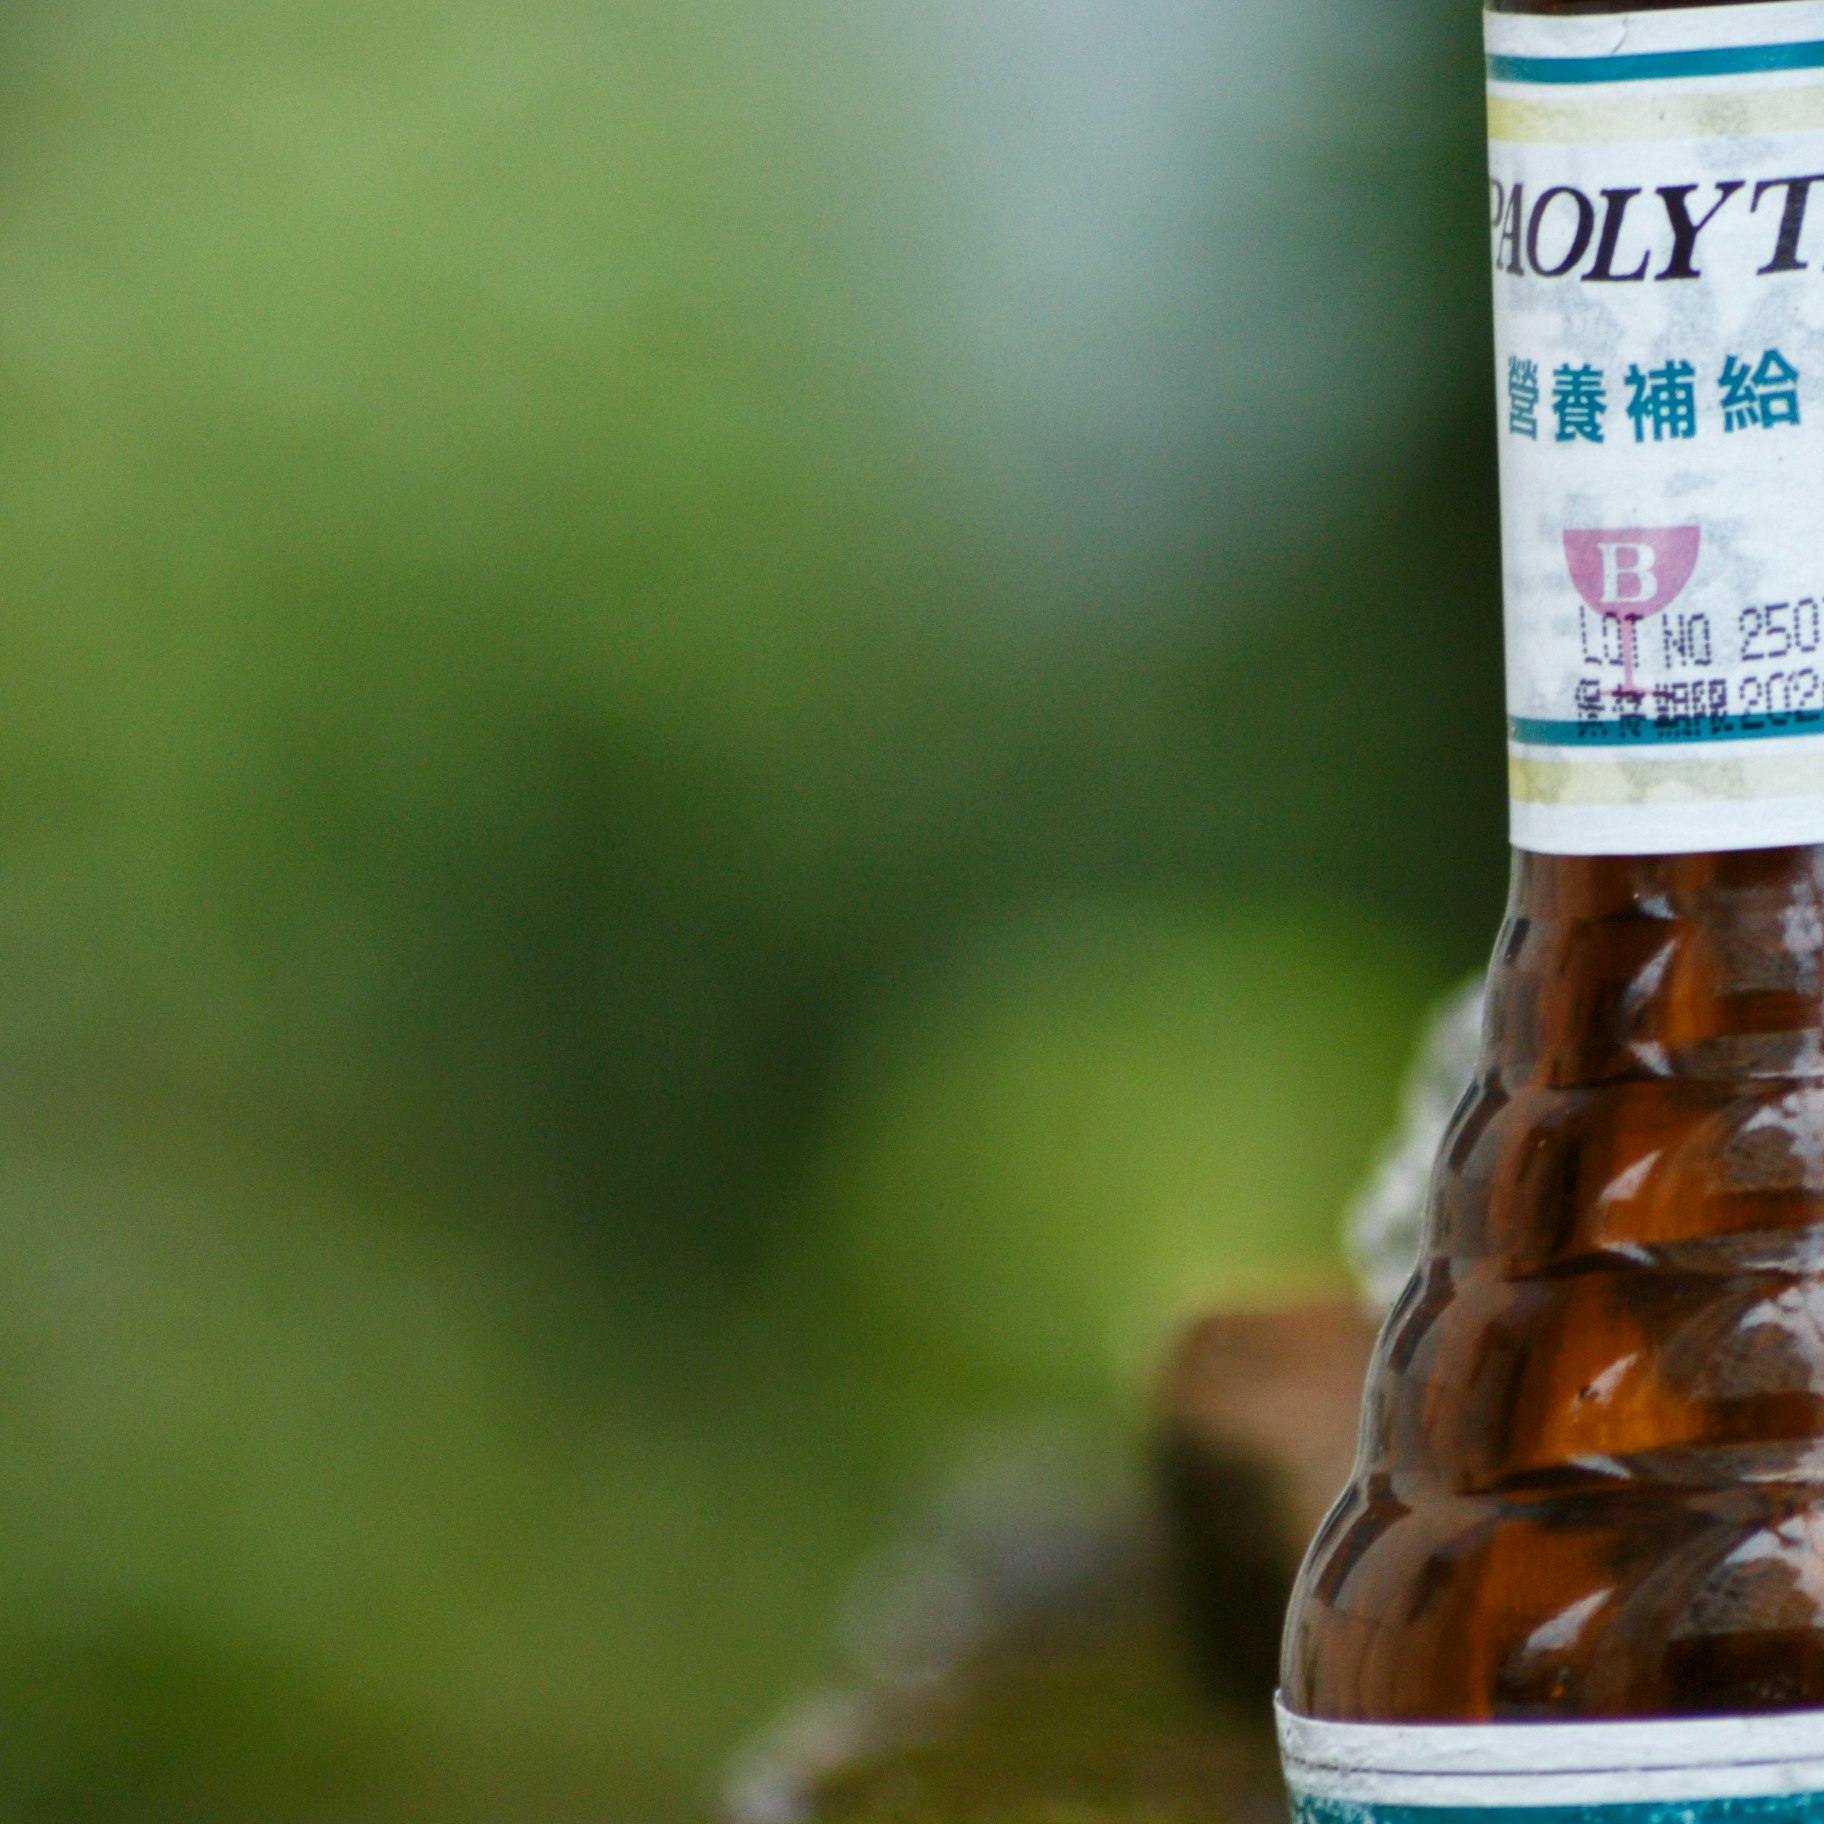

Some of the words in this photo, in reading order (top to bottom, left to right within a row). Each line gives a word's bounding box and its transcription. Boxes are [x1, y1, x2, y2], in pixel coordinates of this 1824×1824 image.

[1507, 347, 1801, 445] 營養補給
[1597, 542, 1658, 603] B
[1579, 605, 1645, 669] LOT
[1662, 613, 1713, 670] NO
